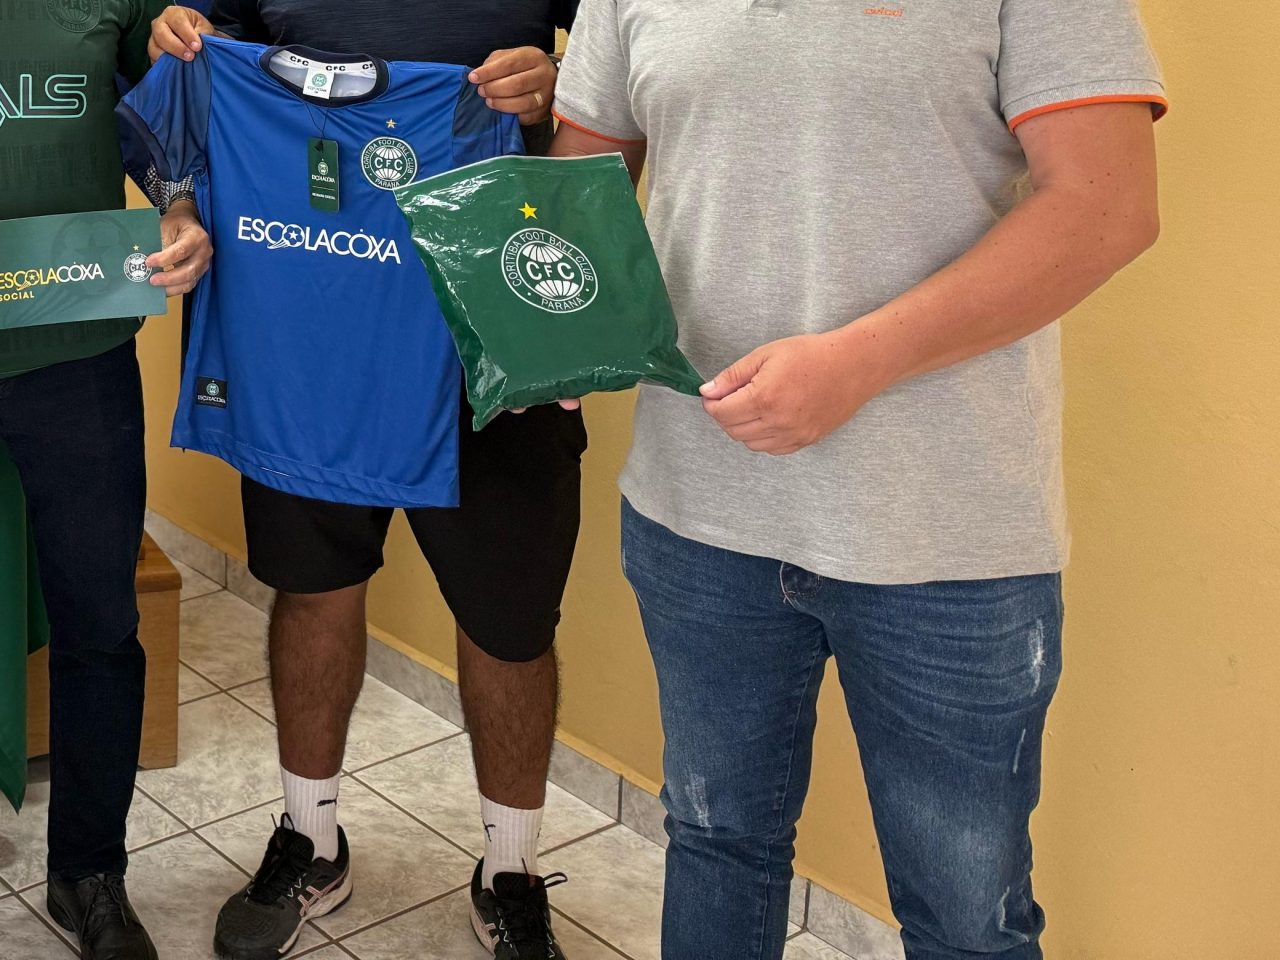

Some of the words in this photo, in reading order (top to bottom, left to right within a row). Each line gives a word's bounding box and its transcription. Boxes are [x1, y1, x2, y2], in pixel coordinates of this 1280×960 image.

[289, 55, 310, 66] CFC
[374, 157, 404, 171] CFC
[238, 215, 402, 265] ESCOLACOXA
[505, 240, 522, 287] CORITIBA
[520, 231, 545, 243] FOOT
[549, 236, 573, 256] BALL
[575, 255, 594, 282] CLUB
[526, 261, 575, 281] CFC
